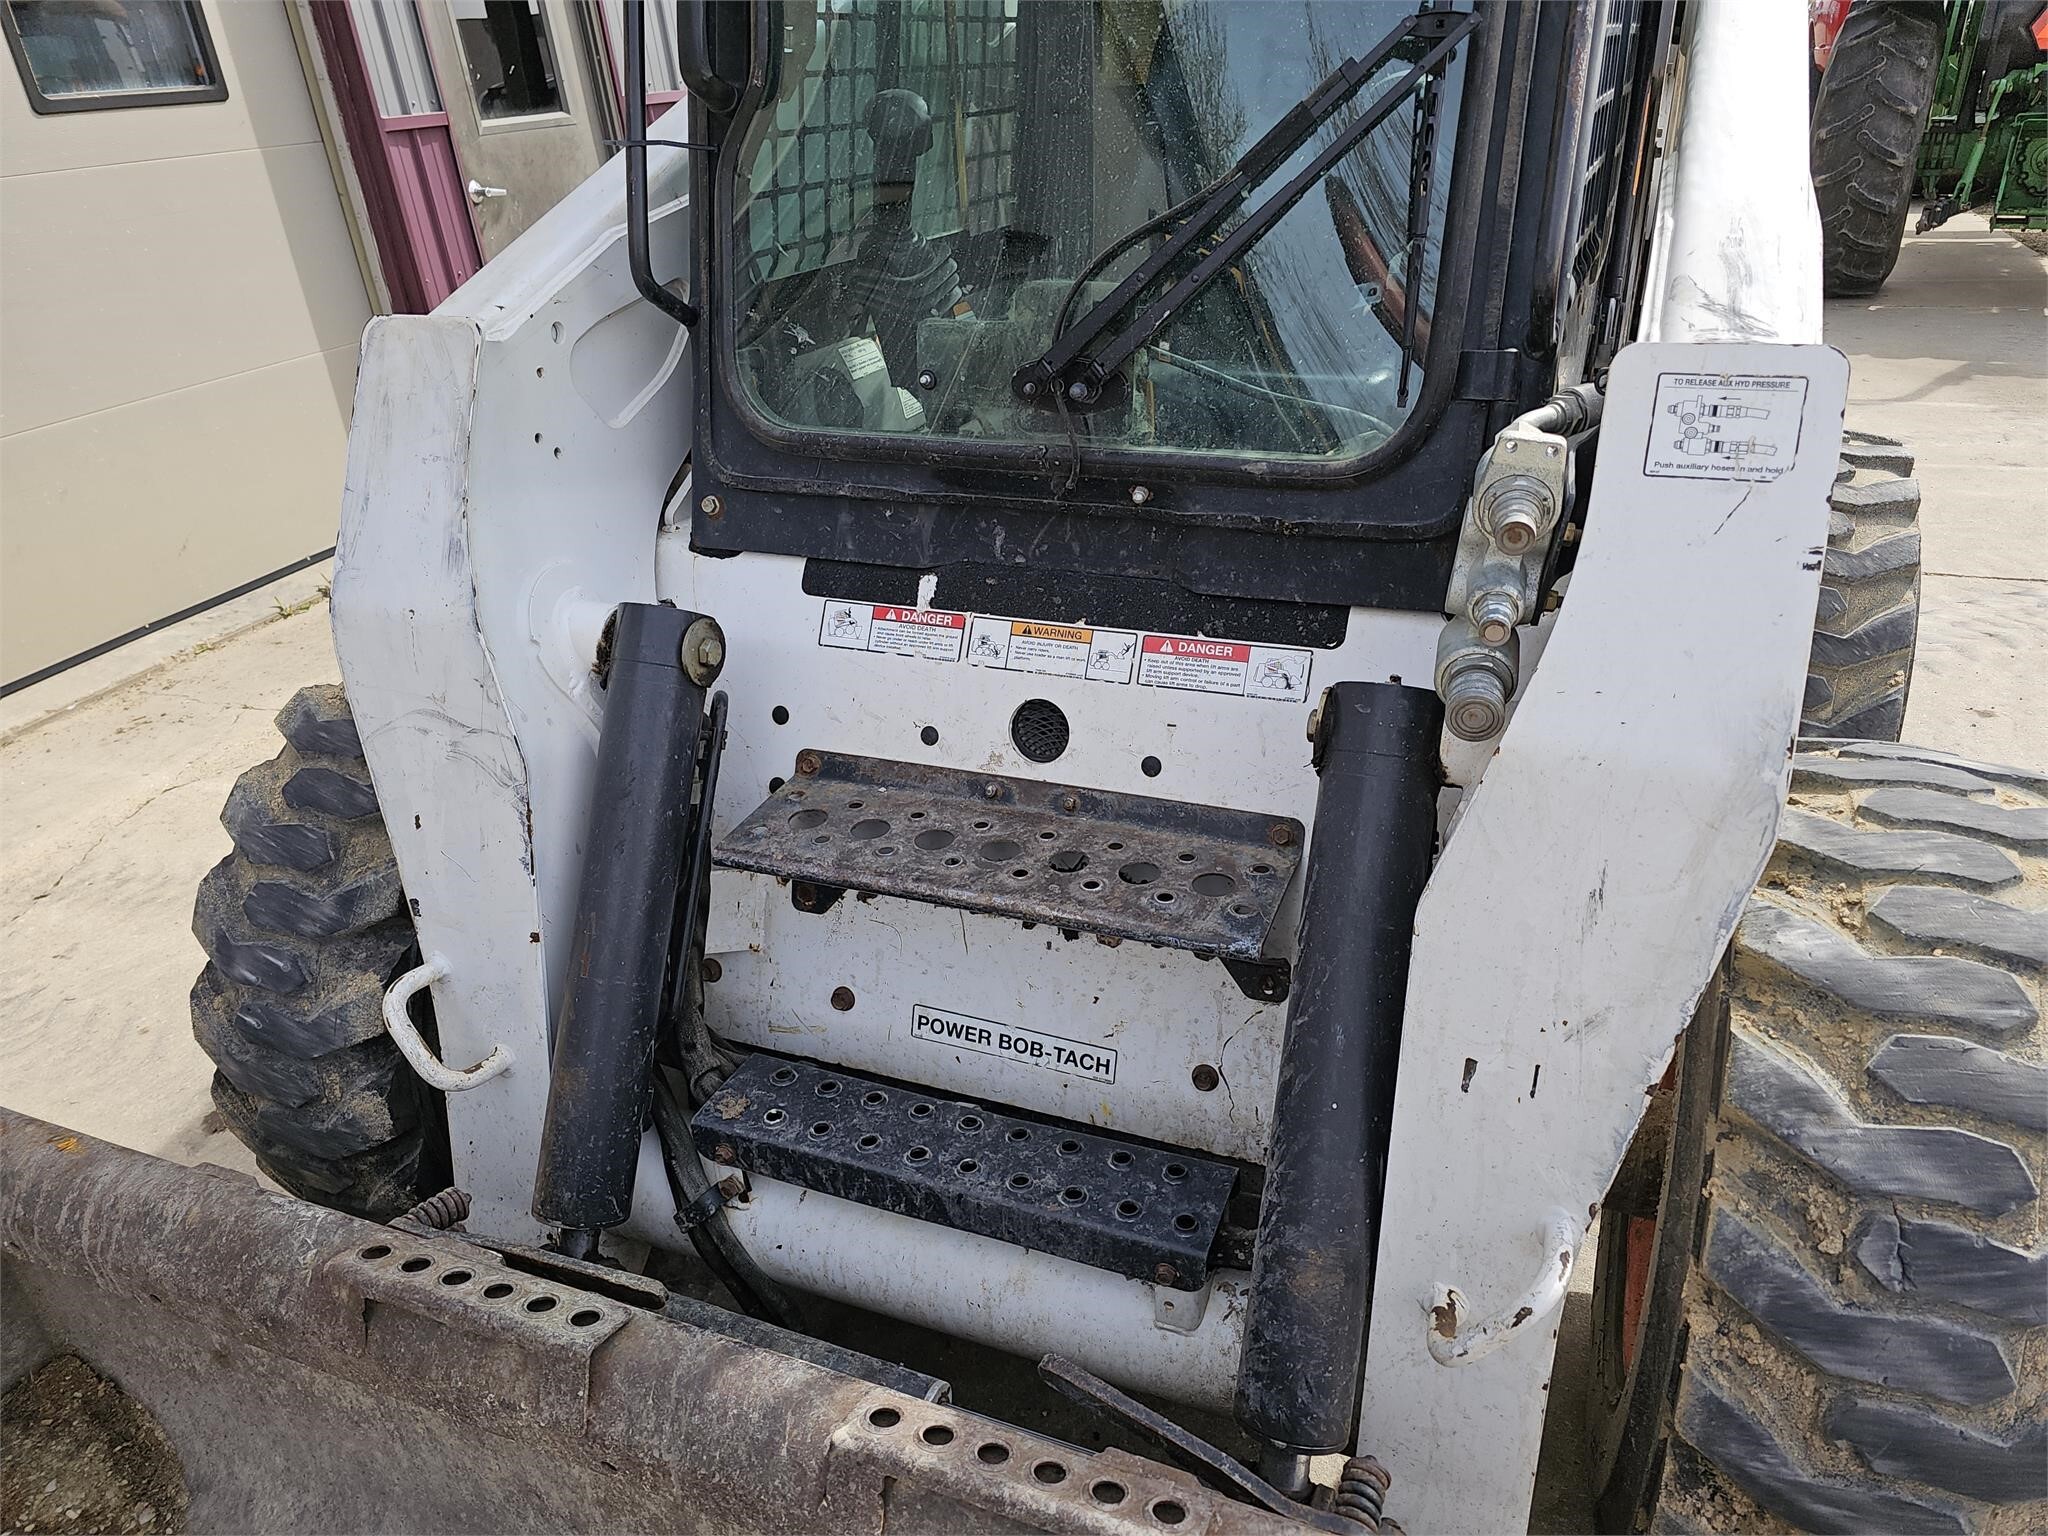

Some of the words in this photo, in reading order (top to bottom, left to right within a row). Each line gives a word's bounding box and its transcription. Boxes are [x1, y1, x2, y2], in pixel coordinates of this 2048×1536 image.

[1686, 378, 1716, 386] RELEASE
[1718, 379, 1732, 387] AUX
[1752, 380, 1790, 389] PRESSURE
[1676, 463, 1709, 472] auxiliary
[902, 611, 952, 626] DANGER
[1034, 626, 1082, 640] WARNING
[1178, 642, 1232, 656] DANGER
[917, 1015, 992, 1046] POWER
[998, 1033, 1110, 1075] BOB-TACH
